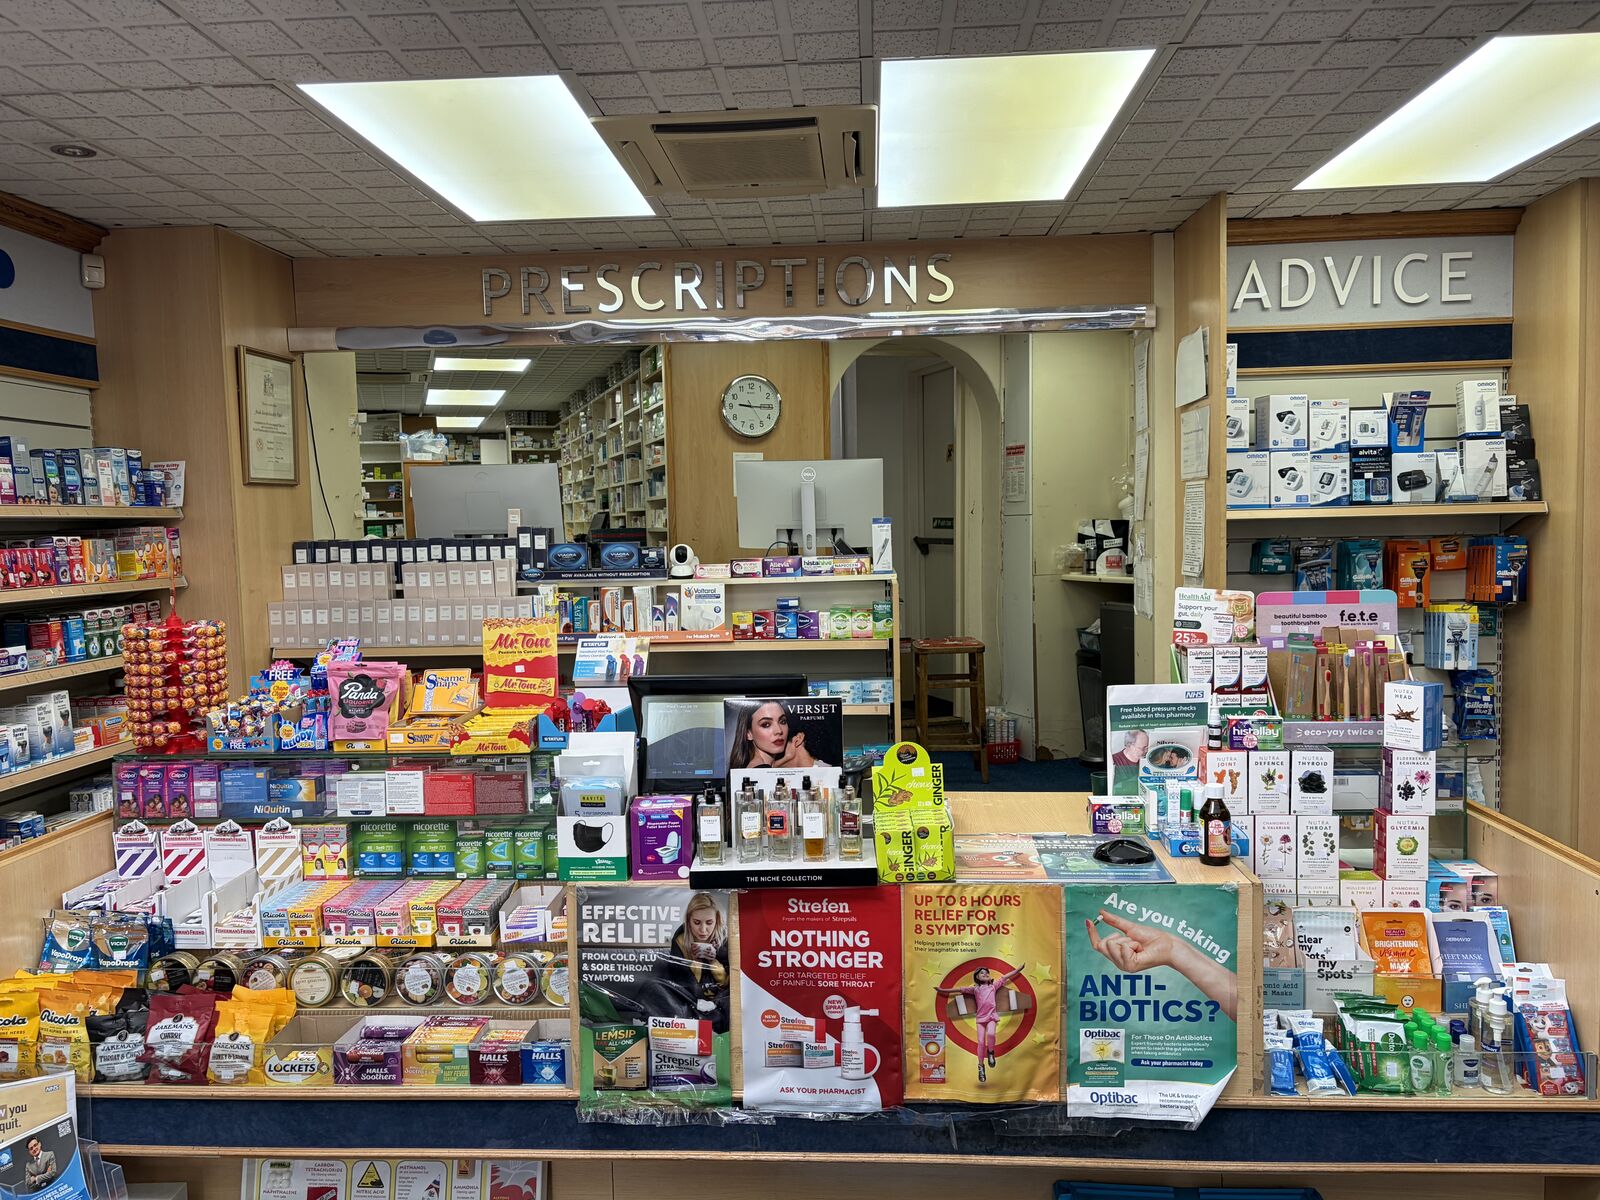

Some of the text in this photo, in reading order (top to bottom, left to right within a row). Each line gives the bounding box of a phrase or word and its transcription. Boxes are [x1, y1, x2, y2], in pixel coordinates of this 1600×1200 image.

[481, 253, 955, 316] PRESCRIPTIONS
[1231, 252, 1473, 311] ADVICE
[1179, 592, 1211, 600] HealthAid
[1340, 609, 1378, 622] f.e.t.e
[517, 632, 552, 648] Tom
[269, 671, 293, 680] FREE
[341, 682, 379, 699] Panda
[788, 704, 837, 714] VERSET
[1232, 727, 1279, 738] histallay
[1304, 728, 1344, 737] eco-yay
[1347, 728, 1374, 736] twice
[120, 770, 137, 779] Calpol
[170, 771, 186, 779] Calpol
[933, 765, 942, 806] GINGER
[254, 805, 290, 814] NiQuitin
[1096, 811, 1141, 822] histallay
[360, 823, 396, 831] nicorette
[788, 898, 850, 913] Strefen
[914, 895, 1021, 907] UP TO 8 HOURS
[582, 905, 681, 922] EFFECTIVE
[915, 909, 996, 921] RELIEF FOR
[583, 923, 672, 944] RELIEF
[915, 924, 922, 935] 8
[1104, 892, 1231, 964] Are you taking
[771, 930, 870, 947] NOTHING
[1297, 935, 1322, 944] Clear
[1298, 944, 1312, 952] my
[610, 953, 638, 962] COLD,
[640, 953, 656, 962] FLU
[758, 951, 883, 968] STRONGER
[1318, 960, 1337, 970] my
[582, 974, 634, 982] SYMPTOMS
[1317, 969, 1352, 980] Spots
[1079, 974, 1166, 997] ANTI-
[1080, 1000, 1220, 1022] BIOTICS?
[41, 1010, 79, 1025] Ricola
[652, 1018, 686, 1029] Strefen
[595, 1029, 636, 1041] LEMSIP
[1084, 1030, 1120, 1039] Optibac
[479, 1054, 508, 1062] HALLS
[655, 1053, 700, 1067] Strepsils
[268, 1063, 315, 1072] LOCKETS
[361, 1073, 396, 1081] Soothers
[1090, 1092, 1138, 1105] Optibac
[9, 1104, 27, 1117] you
[0, 1118, 22, 1132] quit.
